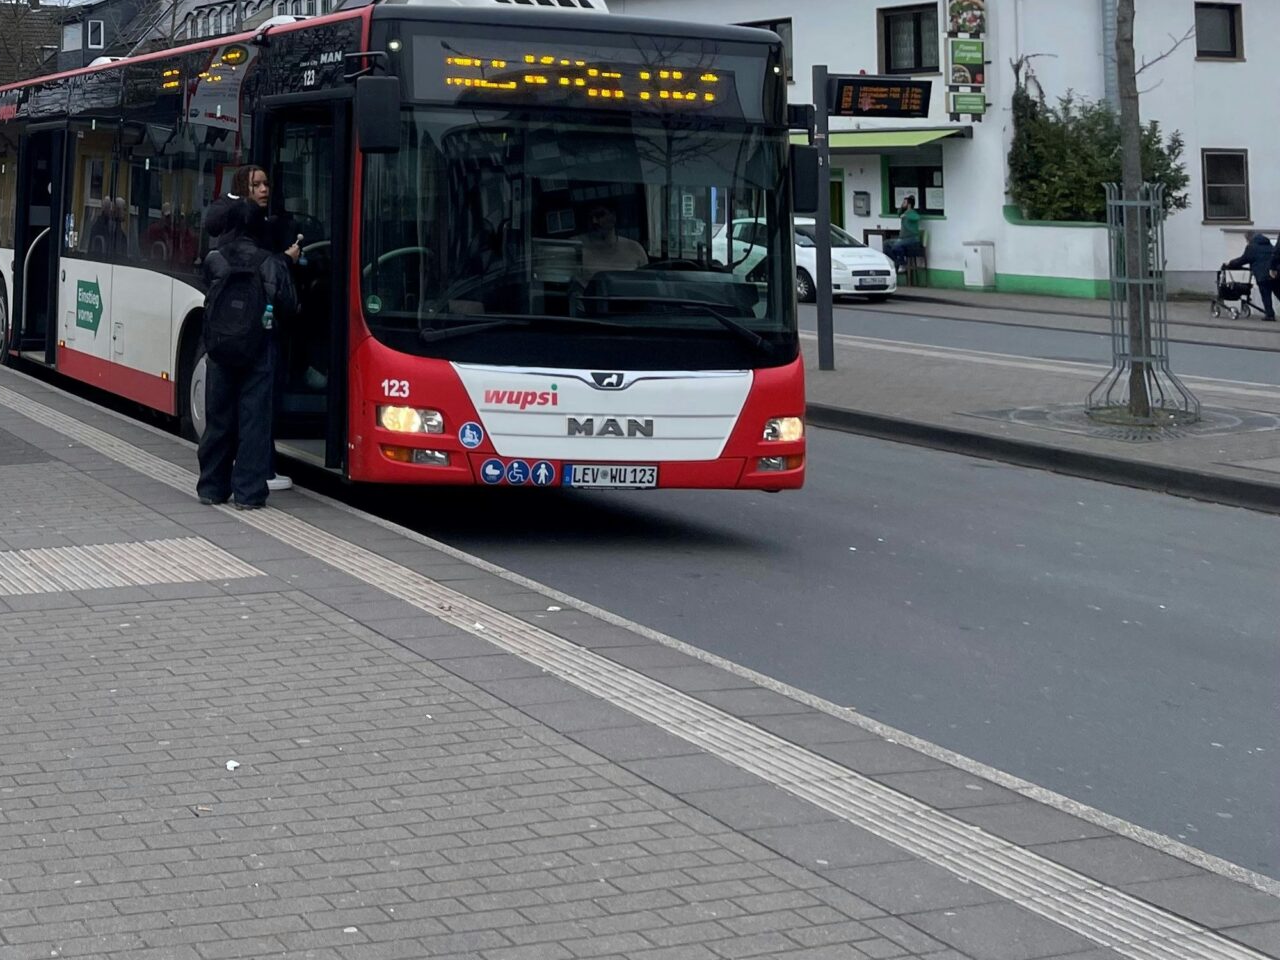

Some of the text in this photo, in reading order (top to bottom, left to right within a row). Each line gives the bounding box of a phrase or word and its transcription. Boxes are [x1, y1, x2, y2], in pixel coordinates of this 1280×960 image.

[320, 50, 342, 64] MAN
[303, 69, 315, 86] 123
[78, 287, 99, 309] Einstieg
[381, 379, 409, 398] 123
[484, 384, 558, 409] wupsi
[567, 417, 654, 437] MAN
[572, 467, 600, 483] LEV
[630, 468, 655, 484] 123
